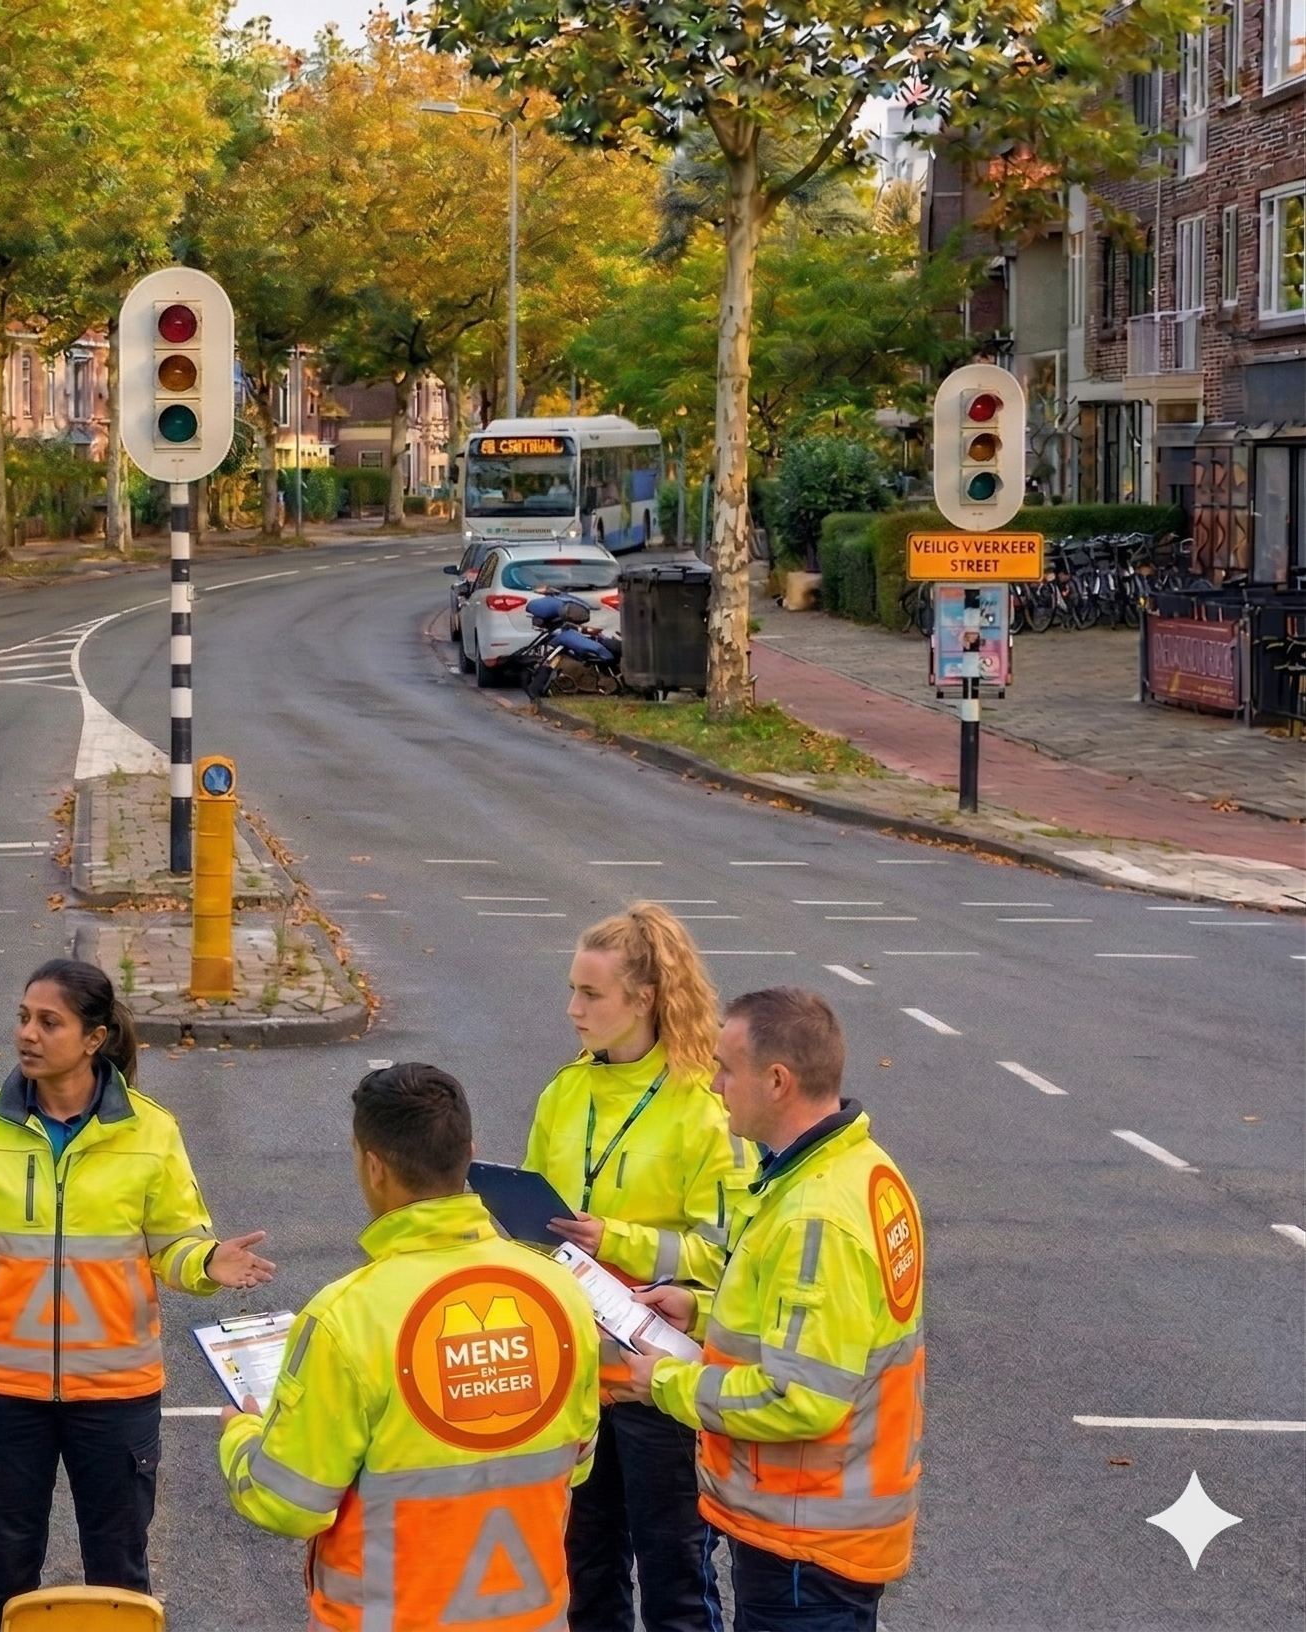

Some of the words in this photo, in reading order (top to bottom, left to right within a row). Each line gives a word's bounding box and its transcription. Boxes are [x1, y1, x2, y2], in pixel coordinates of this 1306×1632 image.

[913, 540, 959, 554] VEILIG
[950, 559, 1000, 573] STREET
[444, 1335, 529, 1369] MENS
[481, 1365, 498, 1378] EN
[447, 1374, 533, 1399] VERKEER
